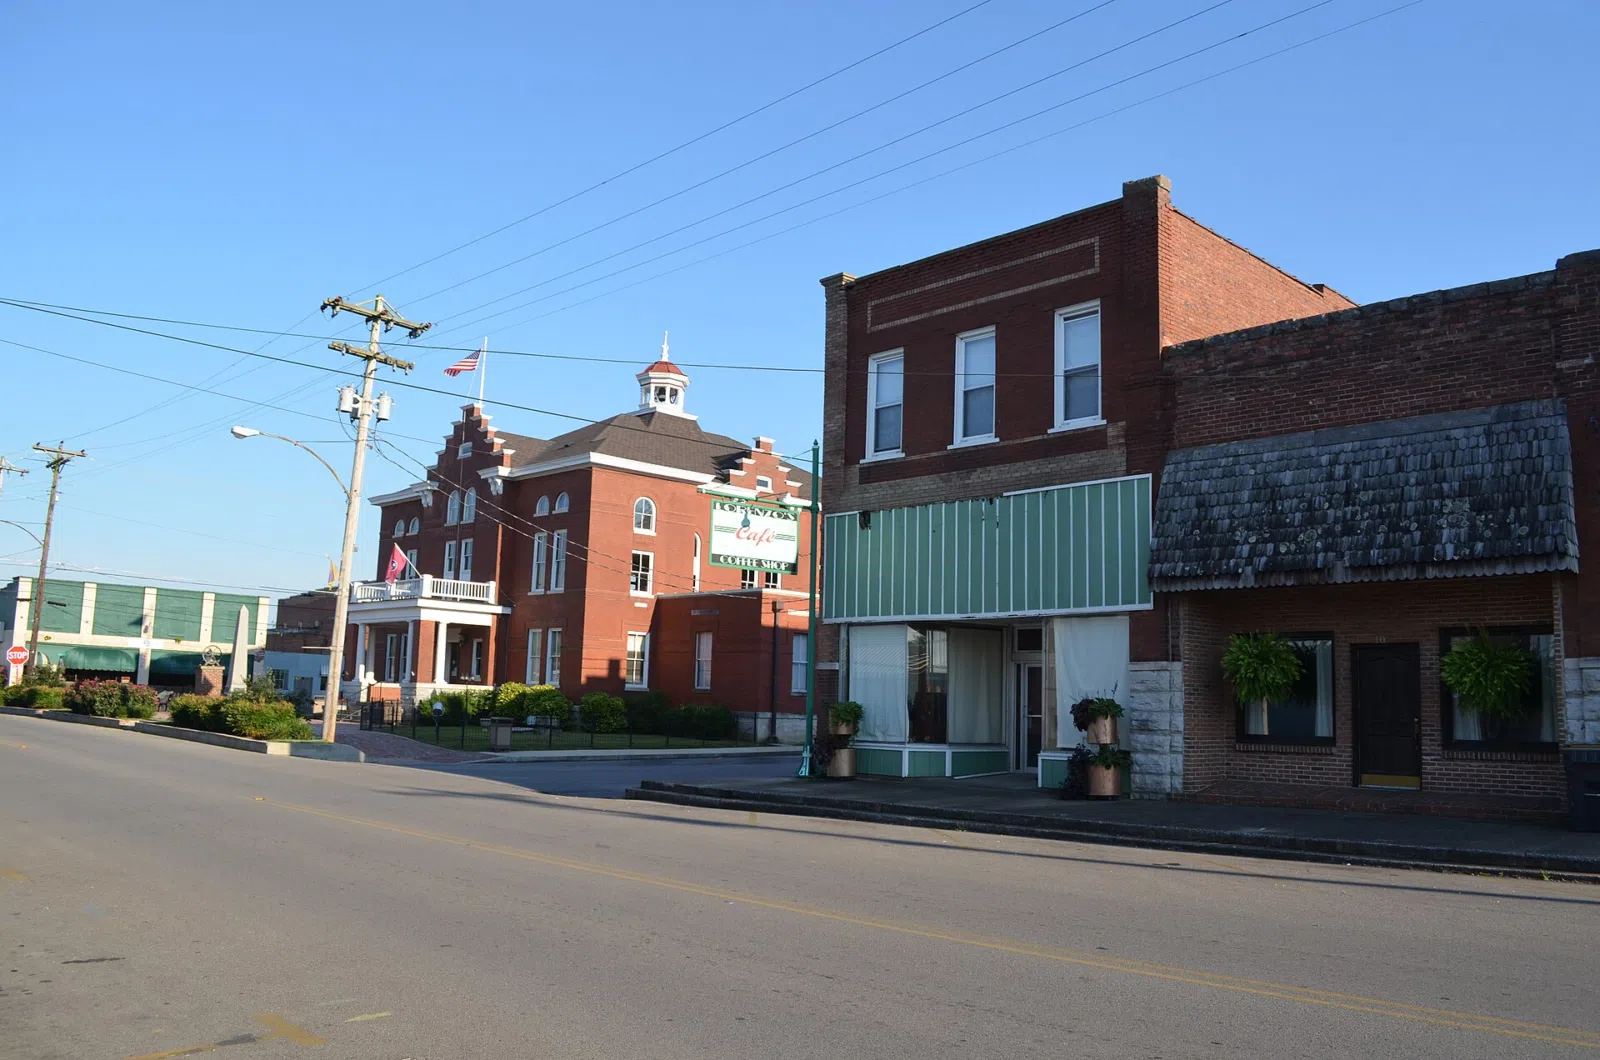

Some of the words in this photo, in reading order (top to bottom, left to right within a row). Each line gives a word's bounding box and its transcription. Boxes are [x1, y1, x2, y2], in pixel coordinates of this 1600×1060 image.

[736, 526, 776, 546] Café
[719, 555, 759, 567] COFFEE
[761, 559, 789, 571] SHOP
[8, 651, 28, 660] STOP
